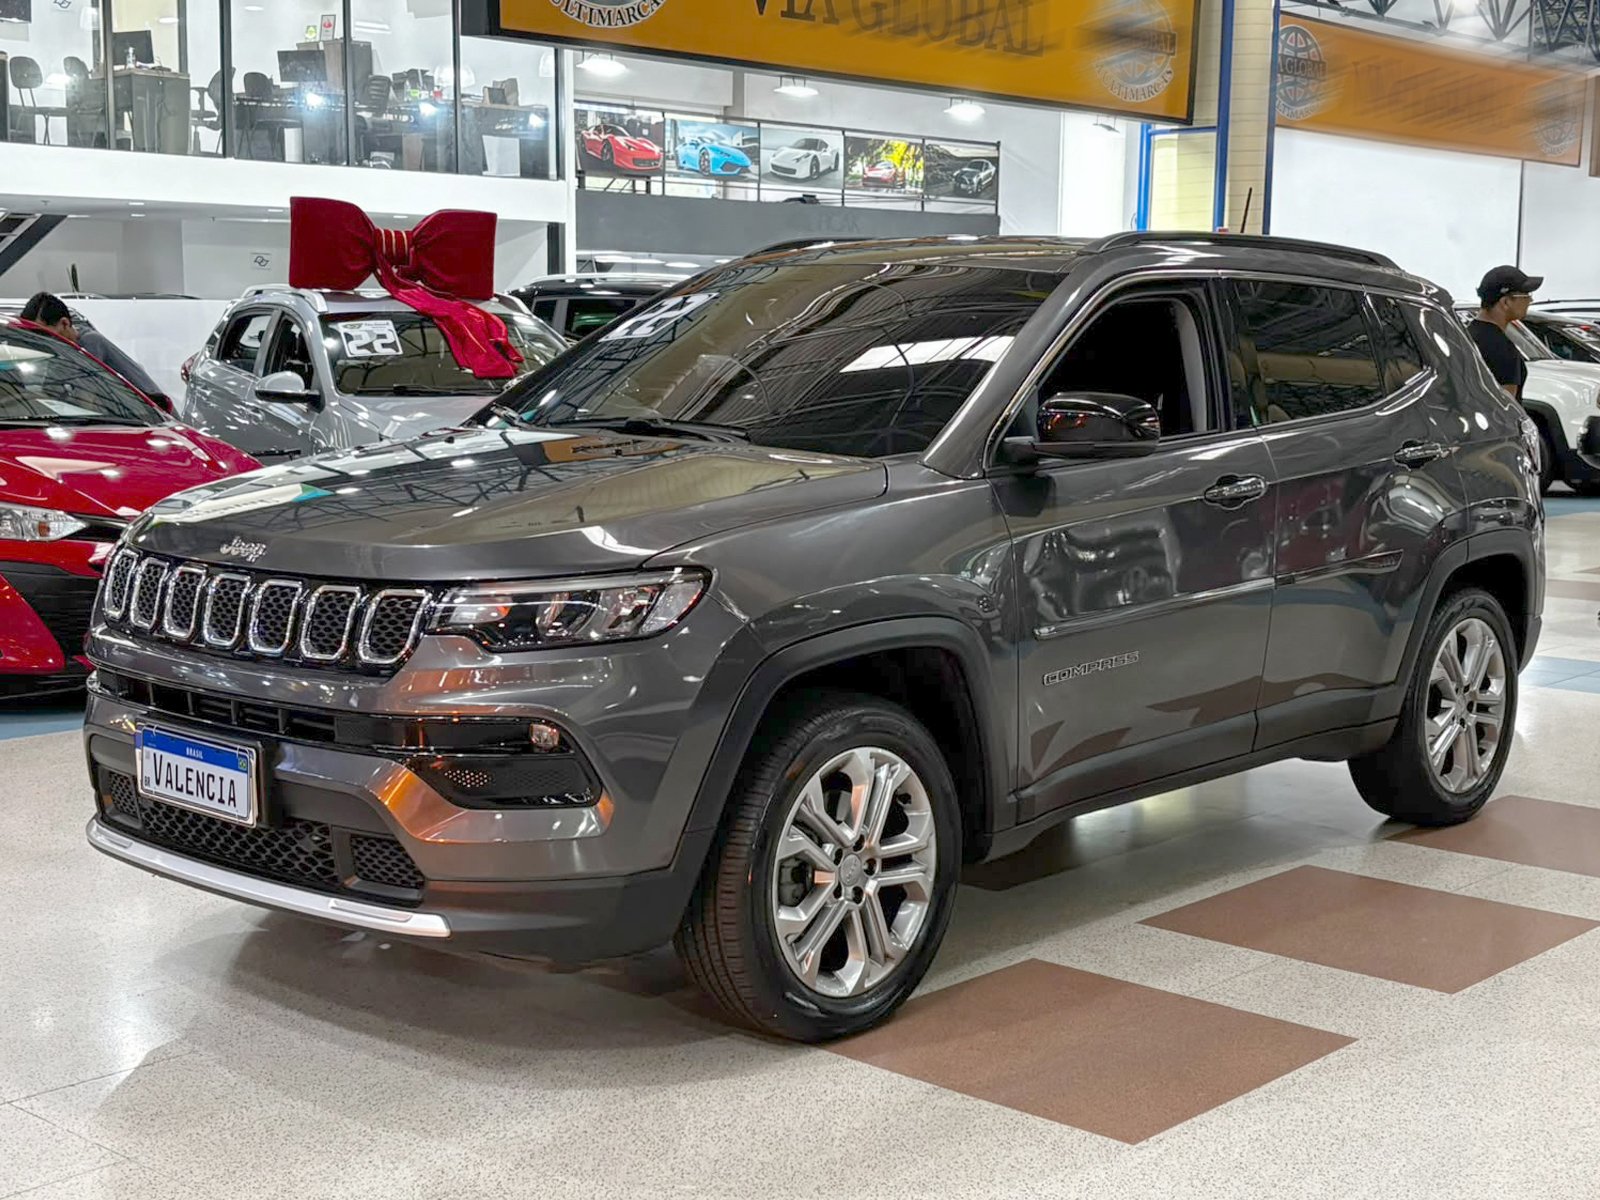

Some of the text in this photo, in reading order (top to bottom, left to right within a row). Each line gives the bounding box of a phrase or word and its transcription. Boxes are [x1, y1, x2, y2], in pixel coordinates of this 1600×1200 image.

[344, 329, 400, 355] 22
[220, 536, 266, 563] Jeep
[1042, 650, 1140, 686] COMPASS
[185, 746, 204, 760] BRASIL
[144, 775, 151, 788] BR
[153, 752, 237, 808] VALENCIA
